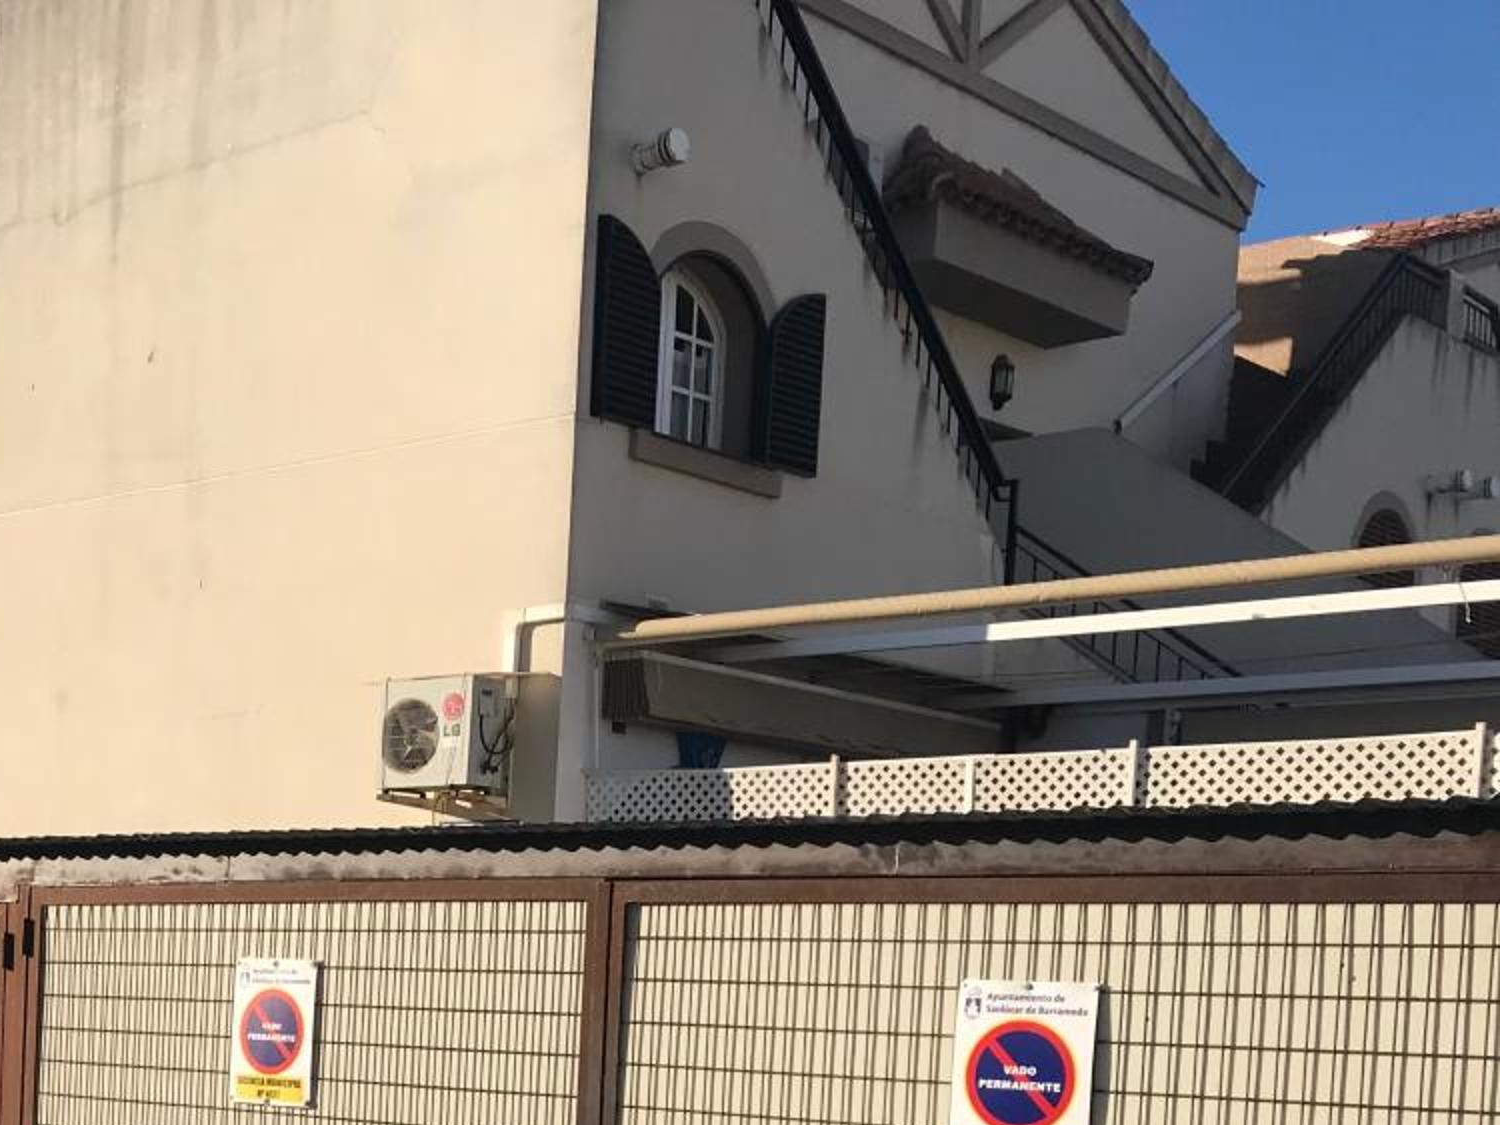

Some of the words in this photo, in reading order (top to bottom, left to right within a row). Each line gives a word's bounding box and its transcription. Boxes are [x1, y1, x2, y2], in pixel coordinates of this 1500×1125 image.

[443, 723, 461, 737] LG
[1003, 1065, 1037, 1076] VADO
[978, 1079, 1061, 1093] PERMANENTE
